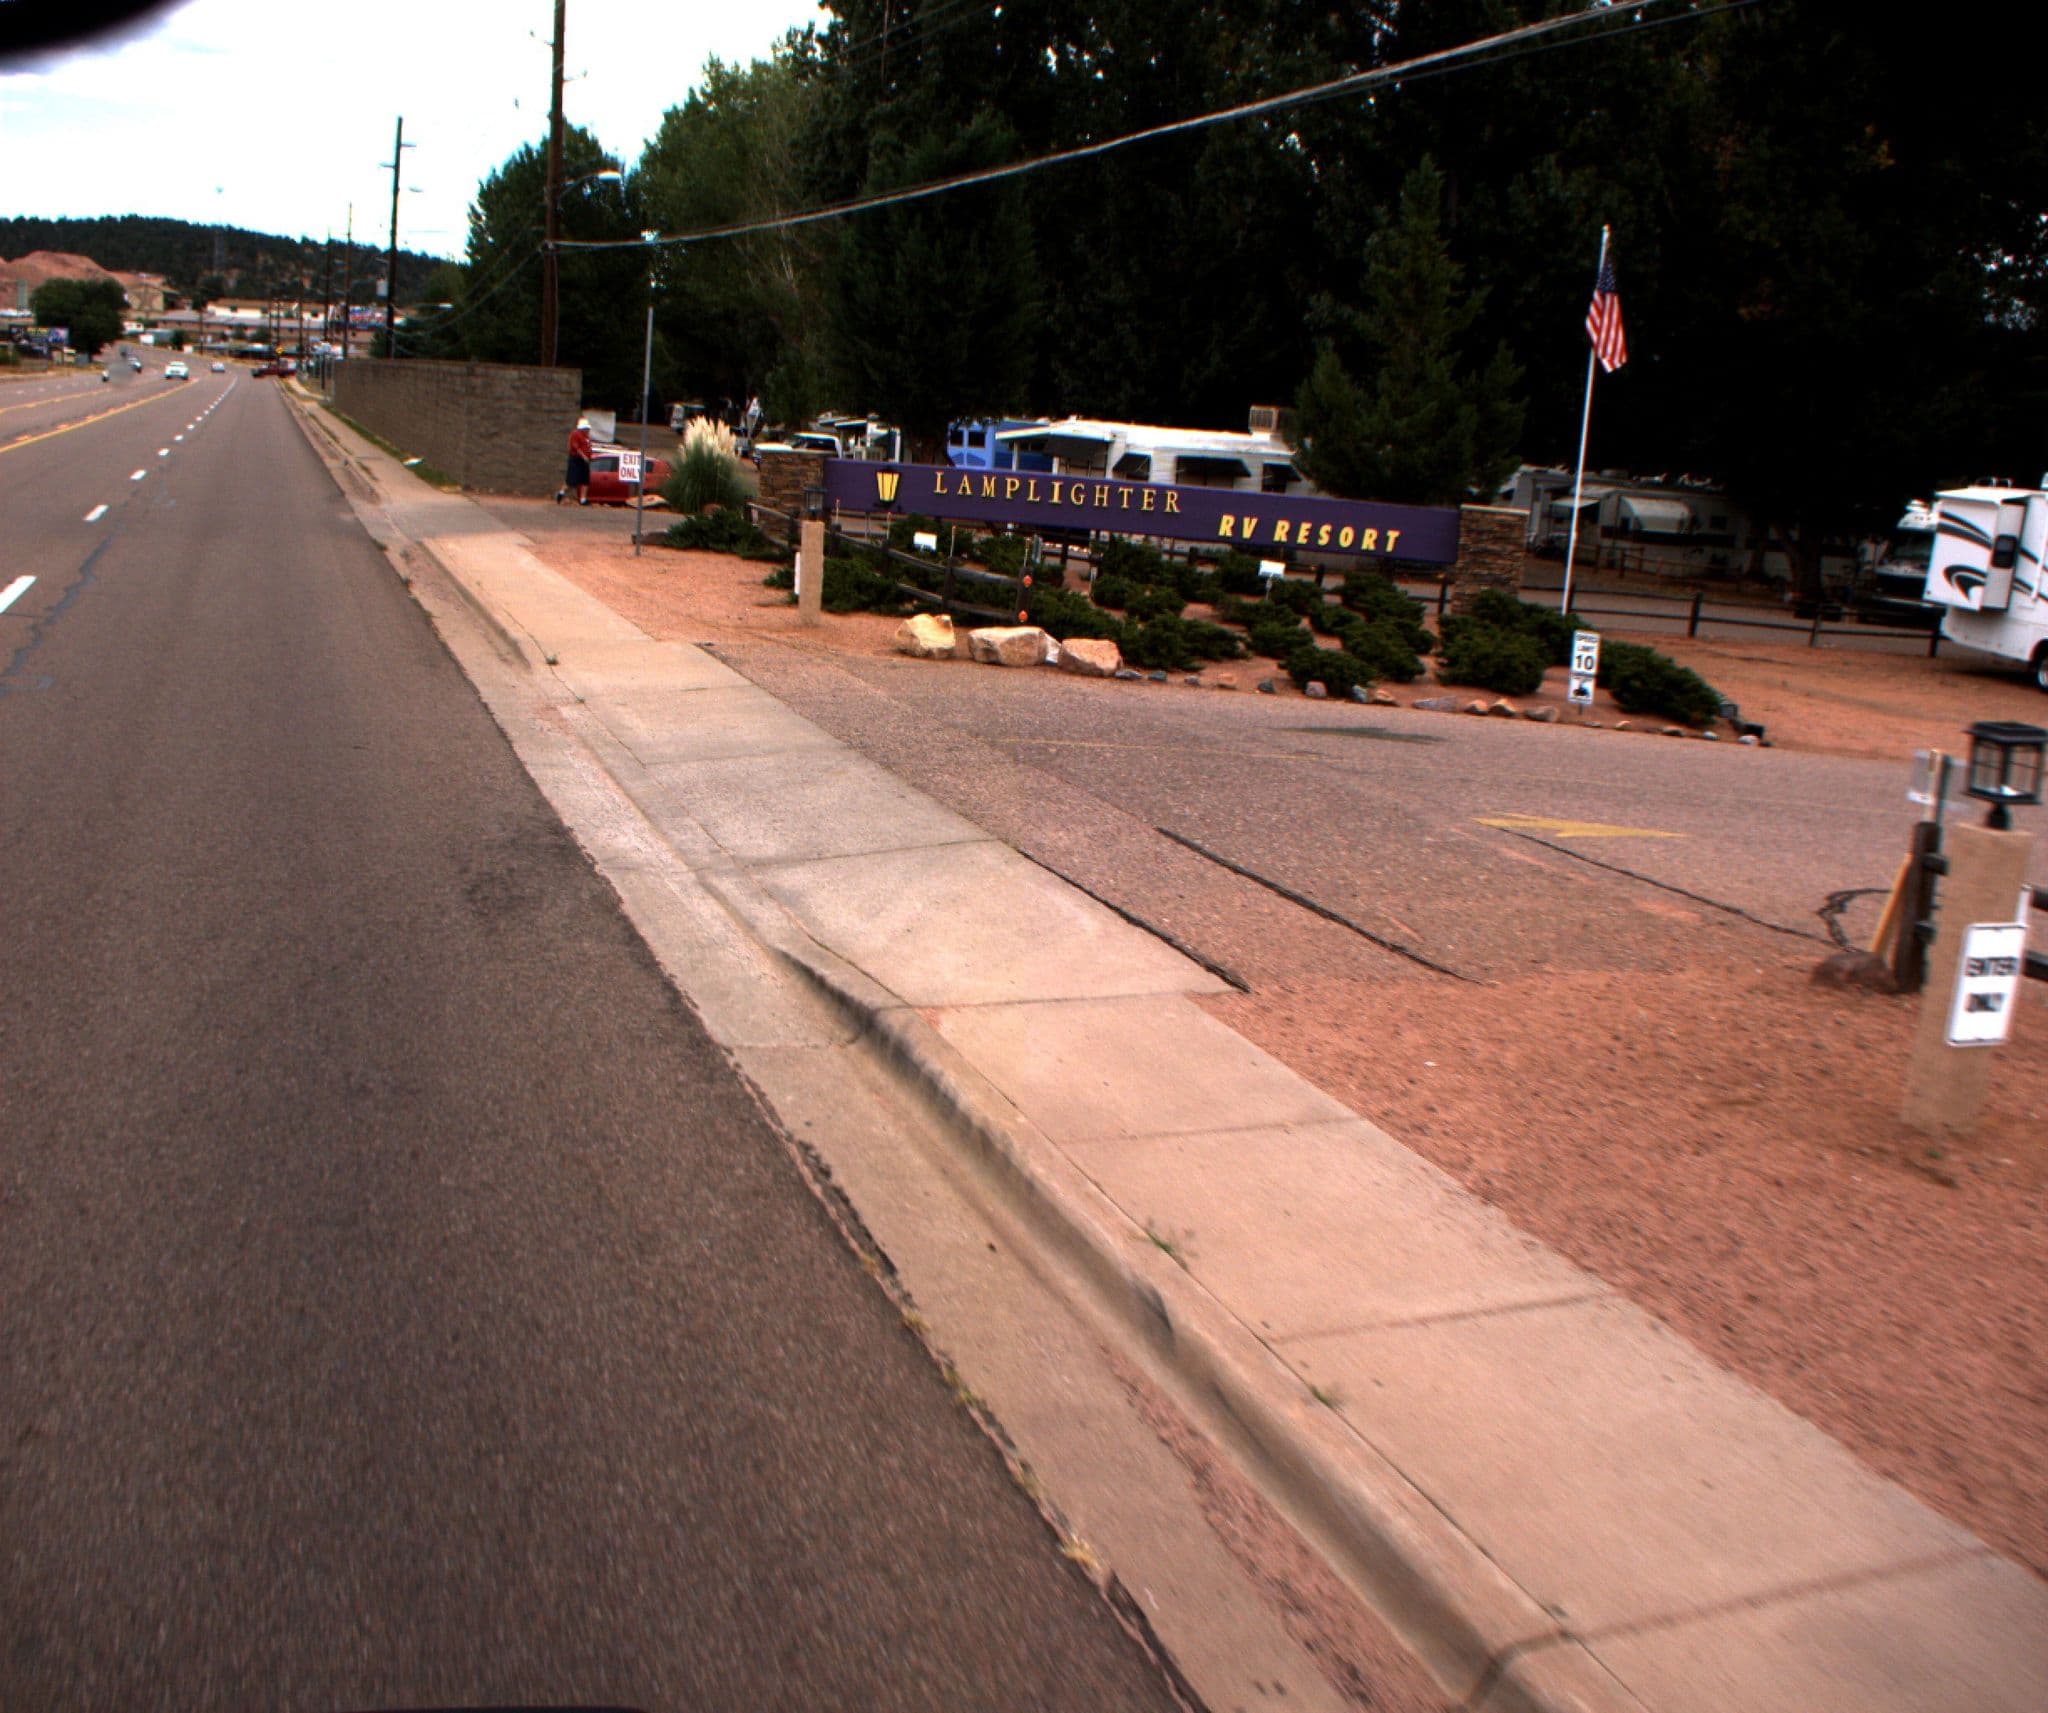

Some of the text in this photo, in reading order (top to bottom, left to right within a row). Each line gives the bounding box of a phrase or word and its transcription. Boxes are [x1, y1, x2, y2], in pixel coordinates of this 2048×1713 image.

[933, 471, 1181, 514] LAMPLIGHTER
[1218, 513, 1401, 553] RV RESORT
[1575, 655, 1594, 670] 10
